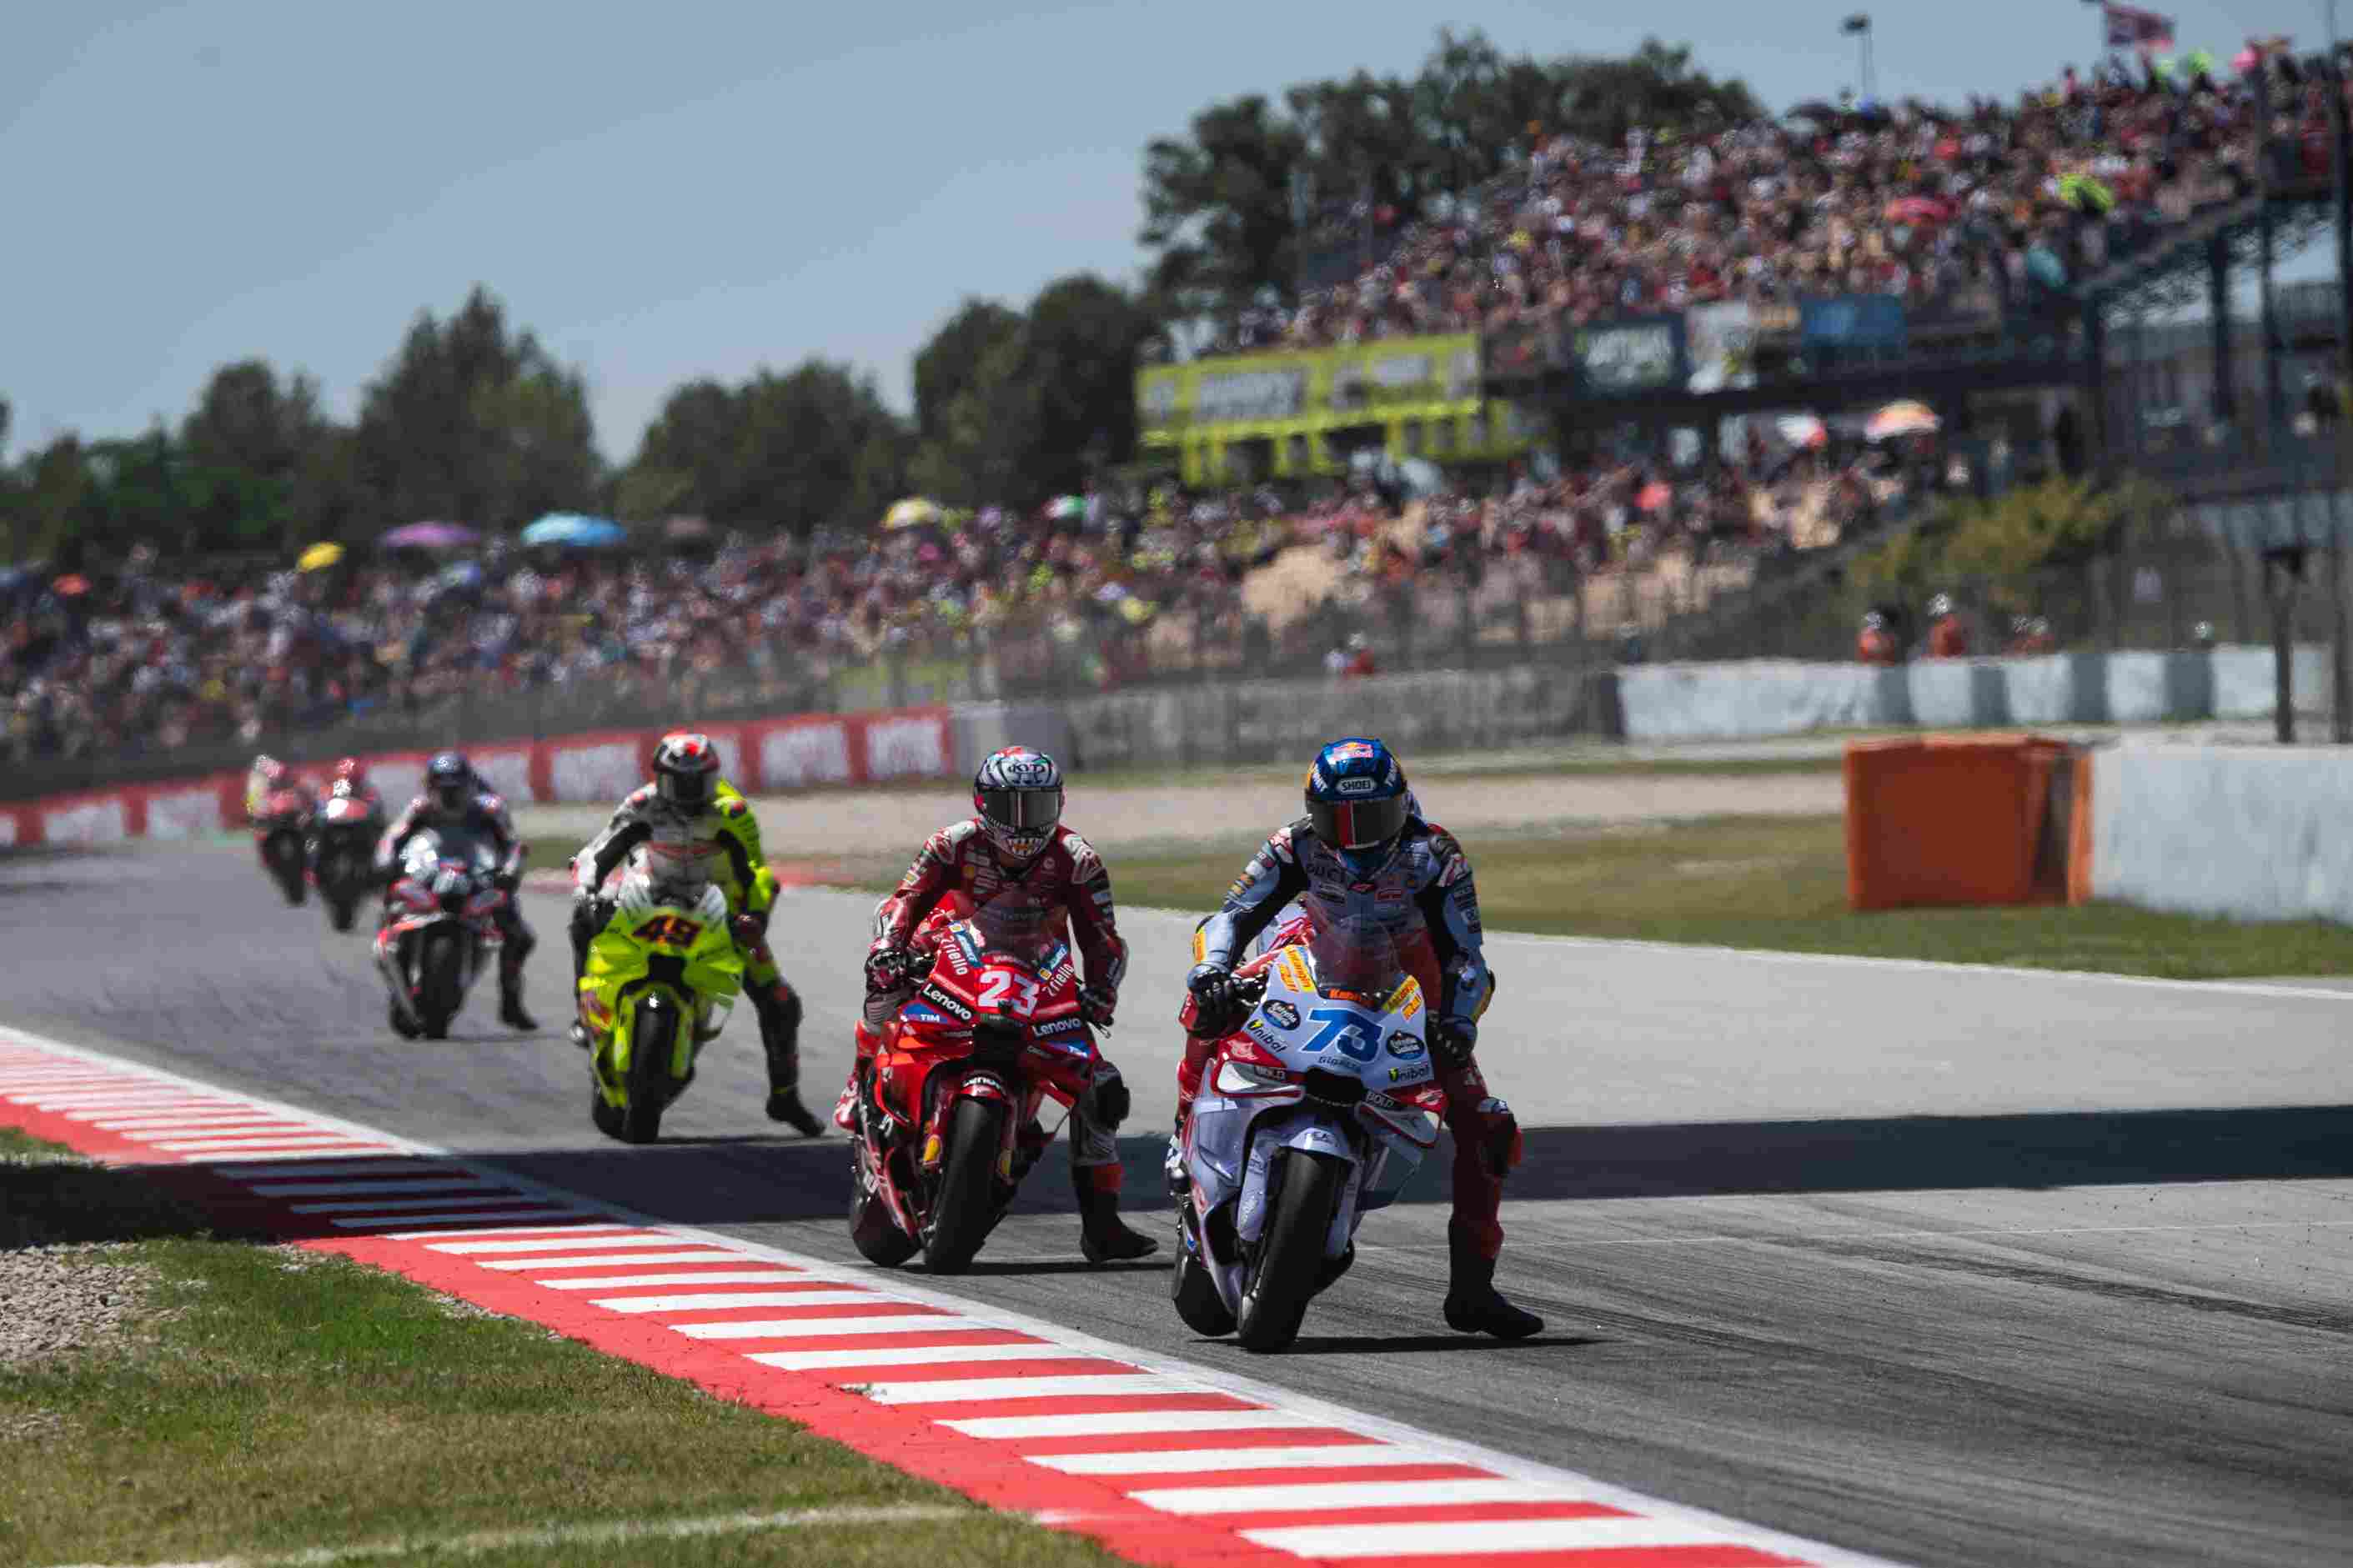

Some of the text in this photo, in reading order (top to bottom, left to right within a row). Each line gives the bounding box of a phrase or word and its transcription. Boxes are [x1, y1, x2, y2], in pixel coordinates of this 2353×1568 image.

[1341, 779, 1372, 791] SHOEI
[922, 984, 972, 1021] Lenovo
[977, 969, 1040, 1016] 23
[921, 1014, 940, 1023] TIM
[1032, 1017, 1081, 1037] Lenovo
[1298, 1007, 1383, 1063] 73
